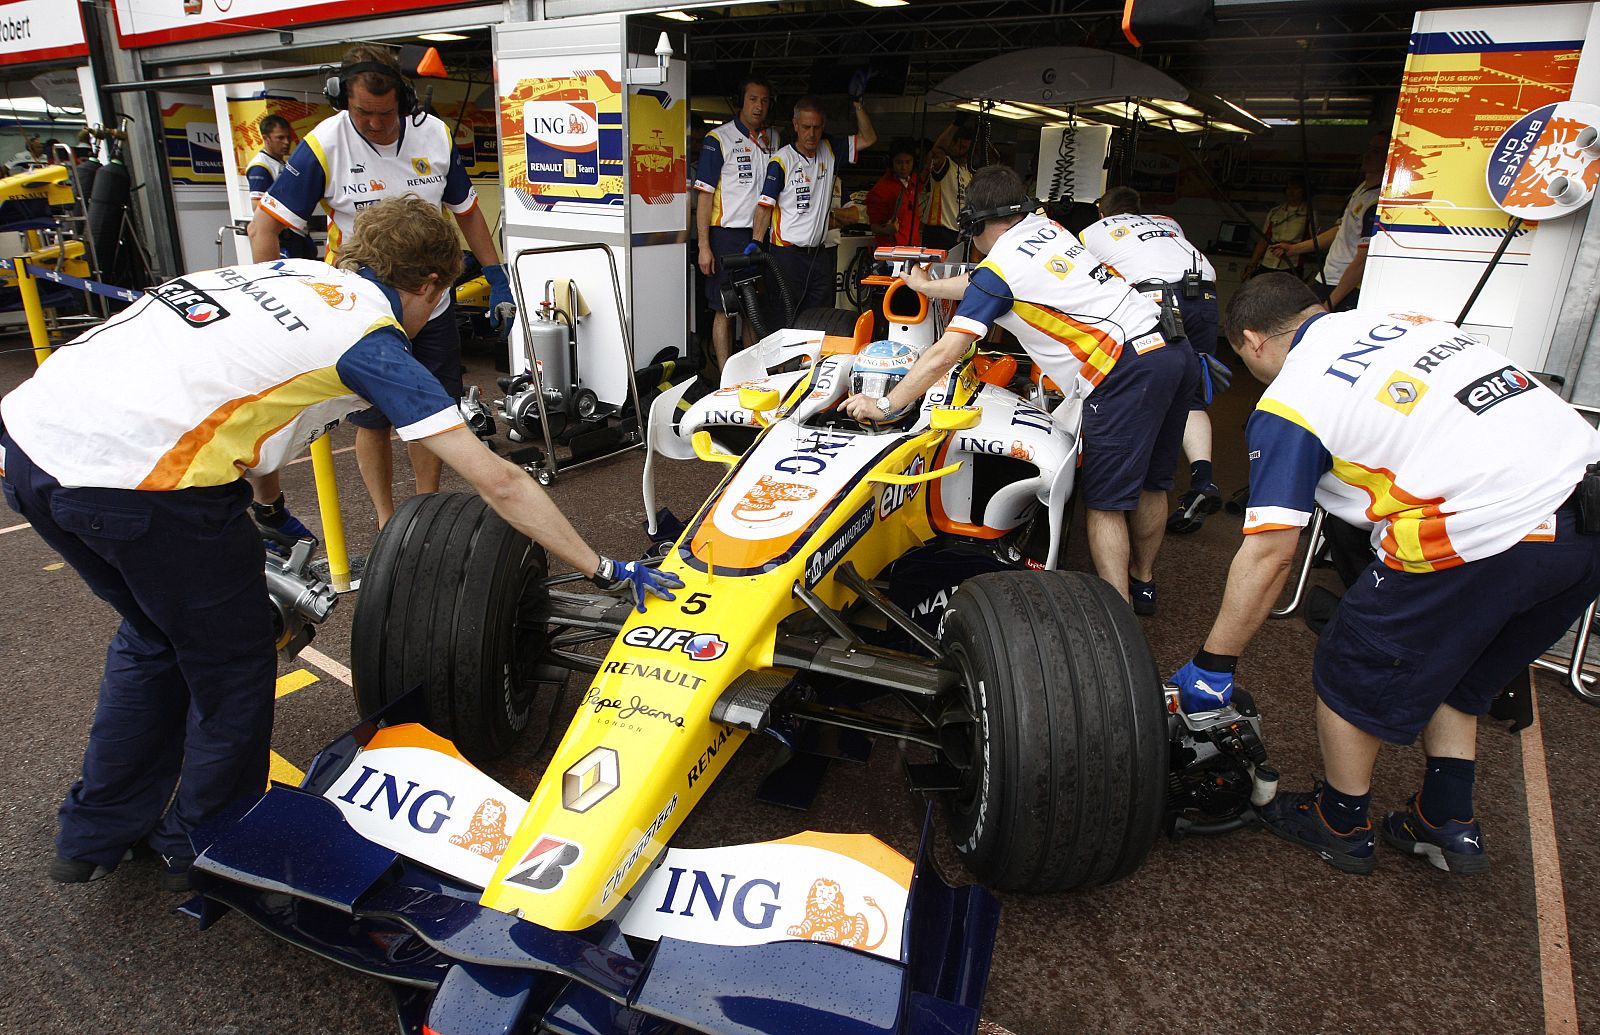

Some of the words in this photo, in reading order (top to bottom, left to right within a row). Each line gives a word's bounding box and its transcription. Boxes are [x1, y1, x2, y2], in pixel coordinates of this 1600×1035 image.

[0, 16, 31, 42] obert
[534, 117, 564, 134] ING
[1497, 138, 1519, 163] ON
[1498, 120, 1543, 187] BRAKES
[407, 175, 444, 187] RENAULT
[530, 162, 563, 172] RENAULT
[577, 164, 595, 174] Team
[343, 183, 368, 195] ING
[1016, 227, 1058, 259] ING
[214, 268, 310, 332] RENAULT
[891, 358, 907, 366] ING
[1323, 323, 1408, 388] ING
[1413, 334, 1480, 374] RENAU
[816, 360, 838, 390] ING
[1467, 376, 1509, 407] elf
[704, 410, 745, 424] ING
[1011, 402, 1055, 435] IN
[774, 431, 858, 475] ING
[960, 437, 1005, 455] ING
[680, 592, 712, 615] 5
[623, 626, 691, 652] elf
[603, 661, 707, 690] RENAULT
[580, 687, 622, 713] Pepe
[618, 695, 686, 728] Jeans
[597, 717, 643, 733] LONDON
[687, 726, 735, 788] RENAU
[338, 765, 456, 834] ING
[656, 866, 781, 930] ING
